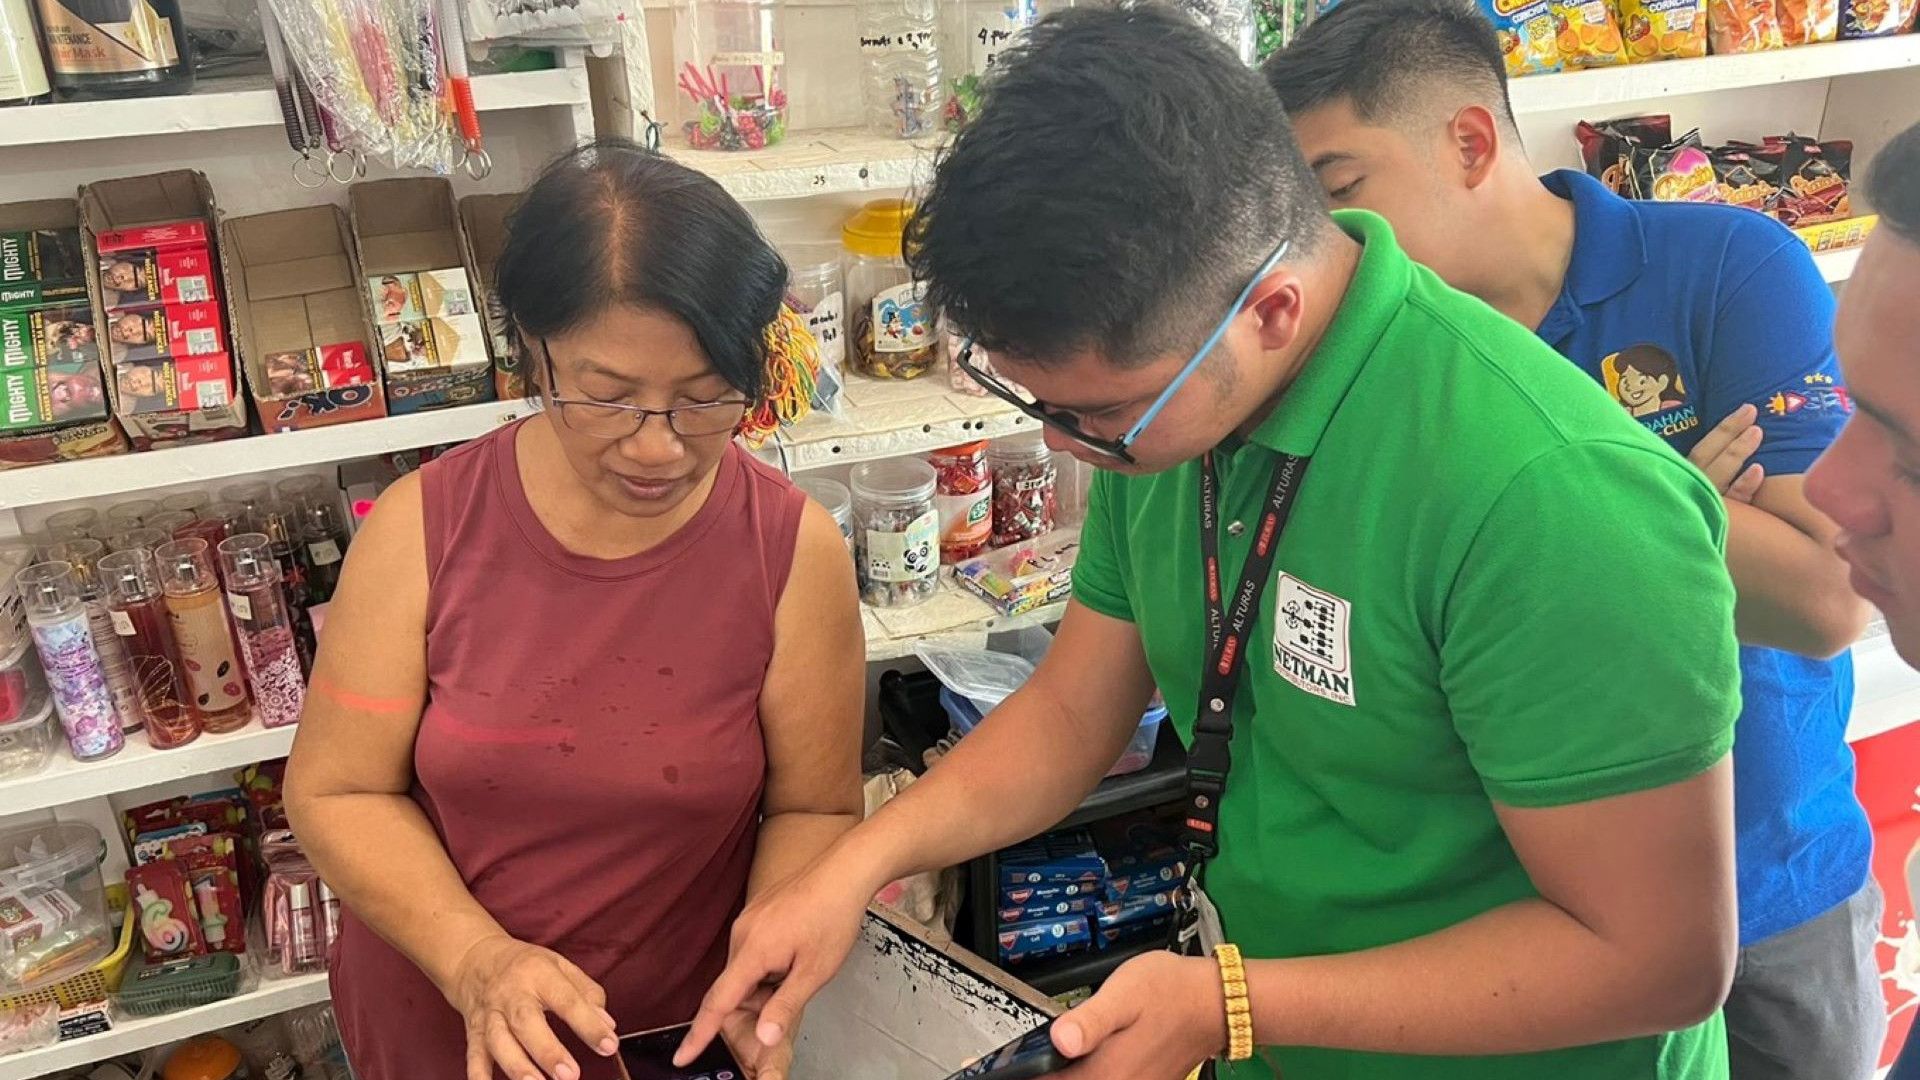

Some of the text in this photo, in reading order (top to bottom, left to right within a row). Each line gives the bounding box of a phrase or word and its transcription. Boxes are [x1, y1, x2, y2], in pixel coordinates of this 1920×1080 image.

[3, 238, 26, 281] MIGHTY
[3, 318, 28, 366] MIGHTY
[7, 375, 33, 423] MIGHTY
[1663, 416, 1699, 436] CLUB
[1231, 580, 1256, 632] ALTURAS
[1274, 643, 1350, 695] NETMAN
